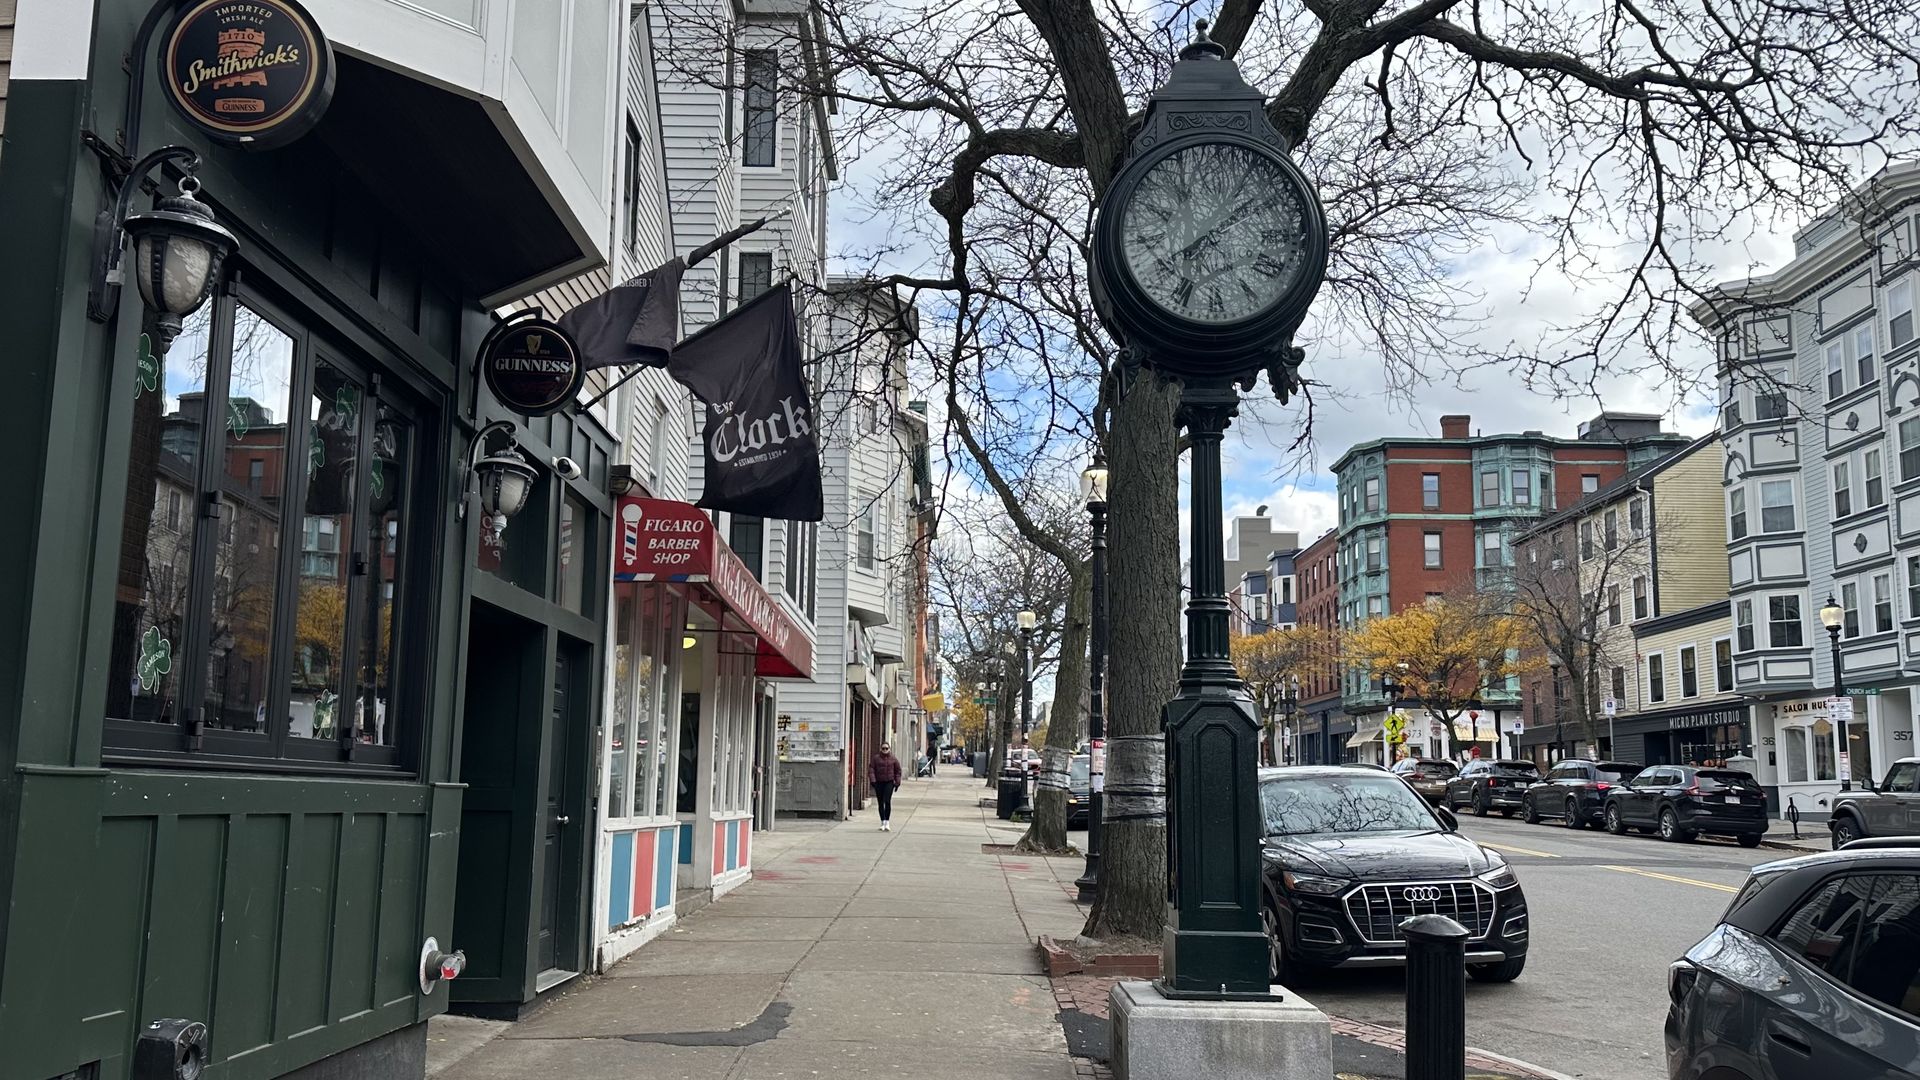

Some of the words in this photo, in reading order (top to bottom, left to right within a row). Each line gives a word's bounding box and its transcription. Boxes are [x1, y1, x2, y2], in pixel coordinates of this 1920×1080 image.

[215, 4, 273, 18] IMPORTED
[221, 15, 247, 24] IRISH
[249, 15, 264, 25] ALE
[228, 32, 255, 40] 1710
[183, 44, 299, 94] Smithwick's
[222, 102, 257, 112] GUINNESS
[495, 358, 570, 373] GUINNESS
[710, 396, 811, 463] Clock
[644, 519, 705, 533] FIGARO
[648, 538, 700, 550] BARBER
[652, 552, 691, 565] SHOP
[144, 650, 166, 673] JAMESON
[1783, 702, 1809, 713] SALON
[1811, 700, 1827, 710] HUE
[1669, 715, 1690, 729] MICRO
[1691, 713, 1713, 727] PLANT
[1714, 710, 1740, 725] STUDIO
[1762, 736, 1776, 746] 36
[1893, 730, 1914, 741] 357
